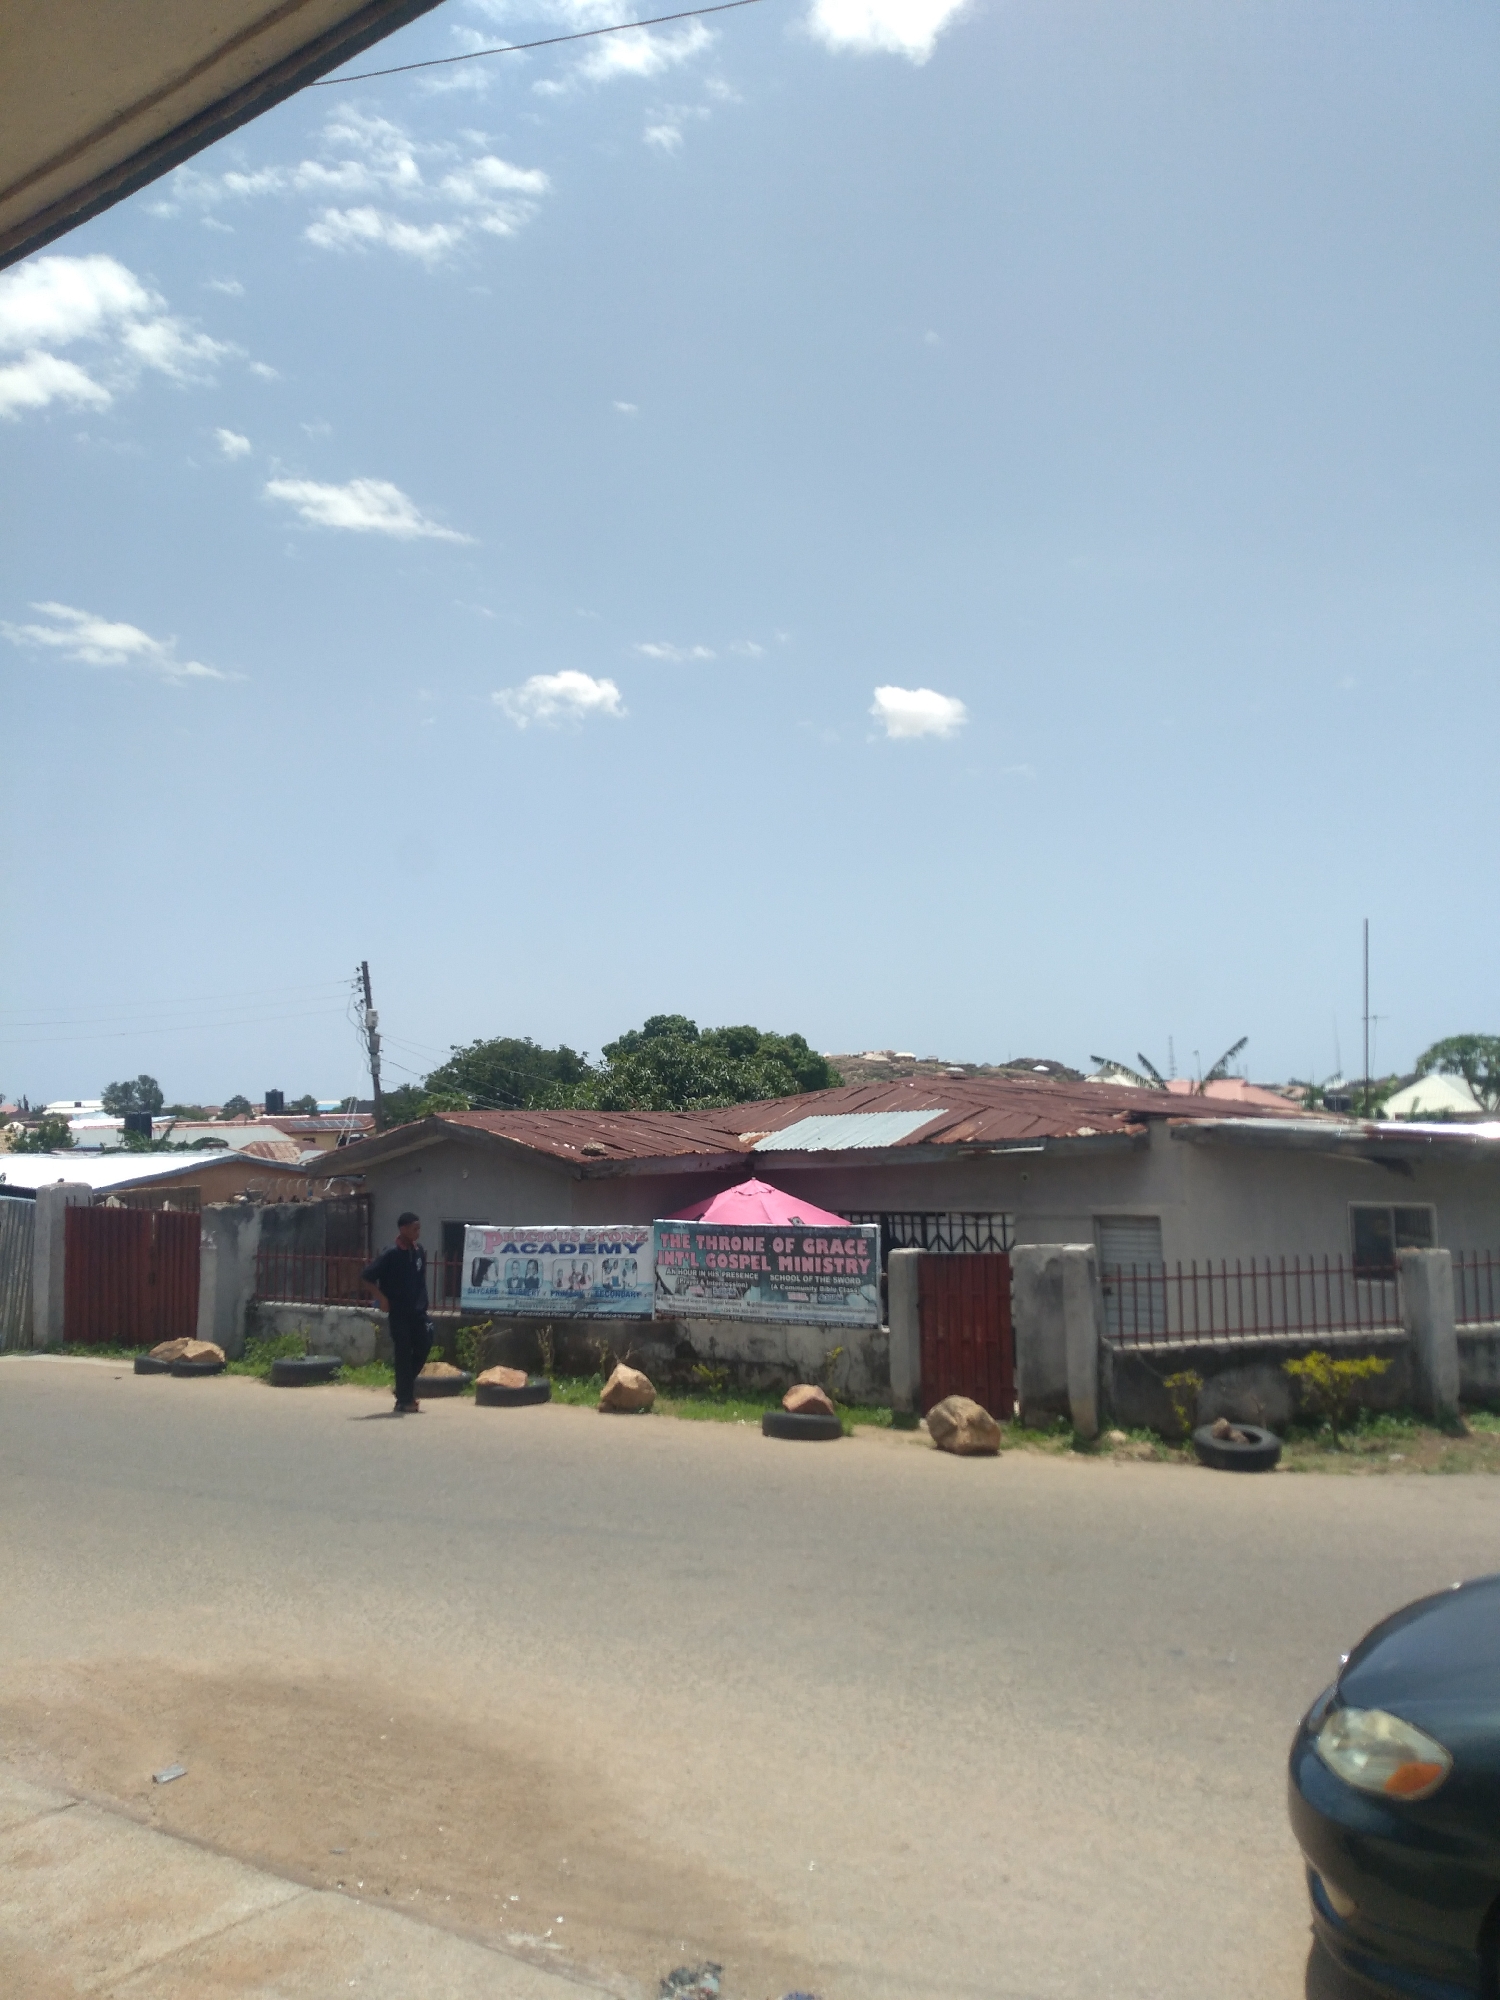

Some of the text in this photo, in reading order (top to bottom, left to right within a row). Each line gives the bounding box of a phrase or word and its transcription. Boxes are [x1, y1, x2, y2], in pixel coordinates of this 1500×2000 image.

[500, 1242, 644, 1255] ACADEMY
[661, 1233, 868, 1255] THE THRONE OF GRACE
[658, 1250, 871, 1275] INT'L GOSPEL MINISTRY
[722, 1271, 759, 1280] PRESENCE
[770, 1274, 800, 1282] SCHOOL
[815, 1275, 830, 1283] THE
[833, 1276, 861, 1284] SWORD
[780, 1284, 817, 1292] Community
